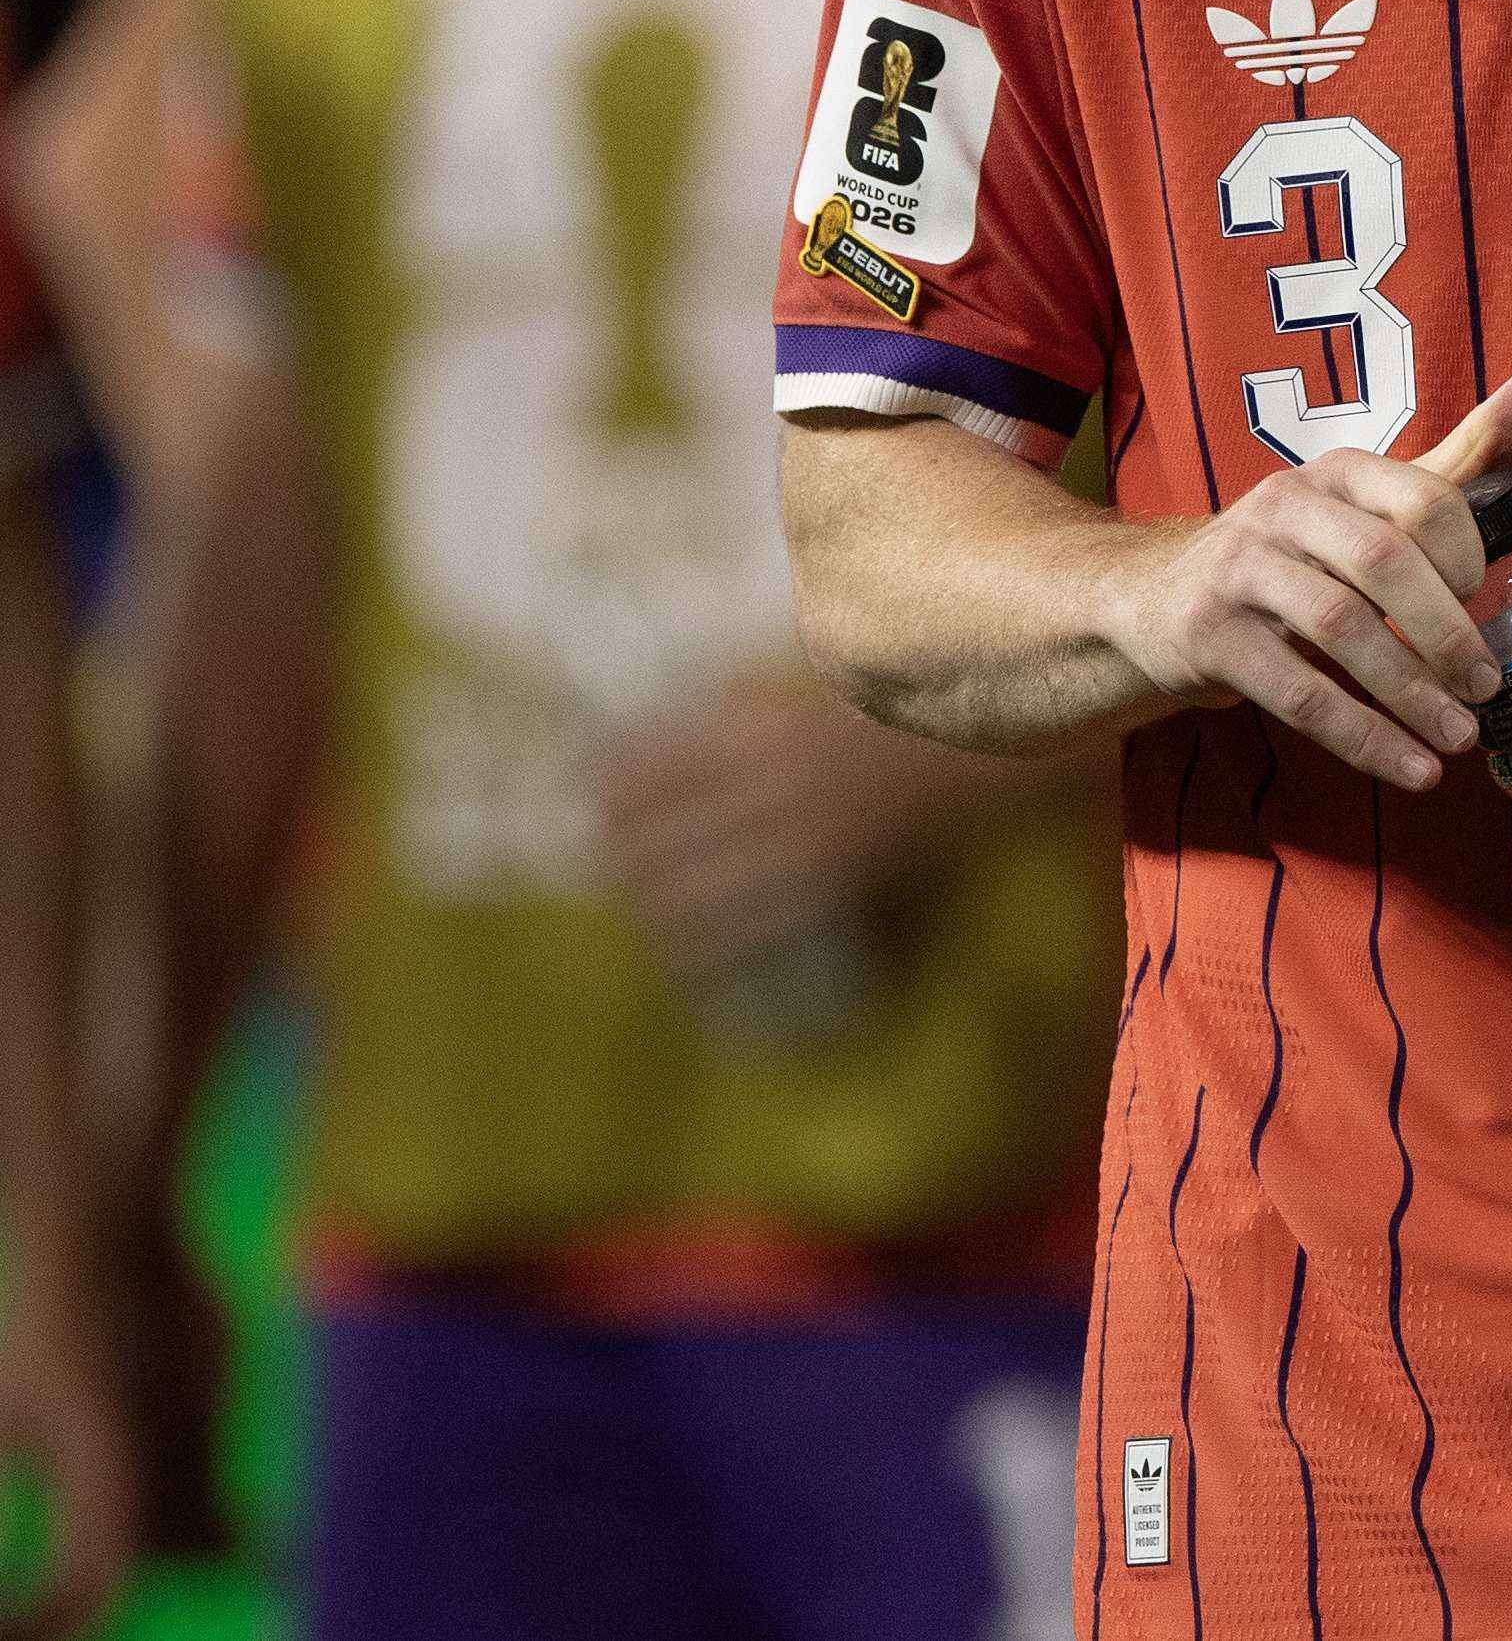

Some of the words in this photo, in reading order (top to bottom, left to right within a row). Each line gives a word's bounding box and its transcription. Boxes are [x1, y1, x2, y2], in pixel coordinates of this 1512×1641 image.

[862, 143, 900, 171] FIFA
[833, 192, 916, 235] 026
[837, 173, 885, 201] WORLD
[887, 193, 919, 211] CUP
[838, 237, 911, 295] DEBUT
[1216, 115, 1417, 466] 3
